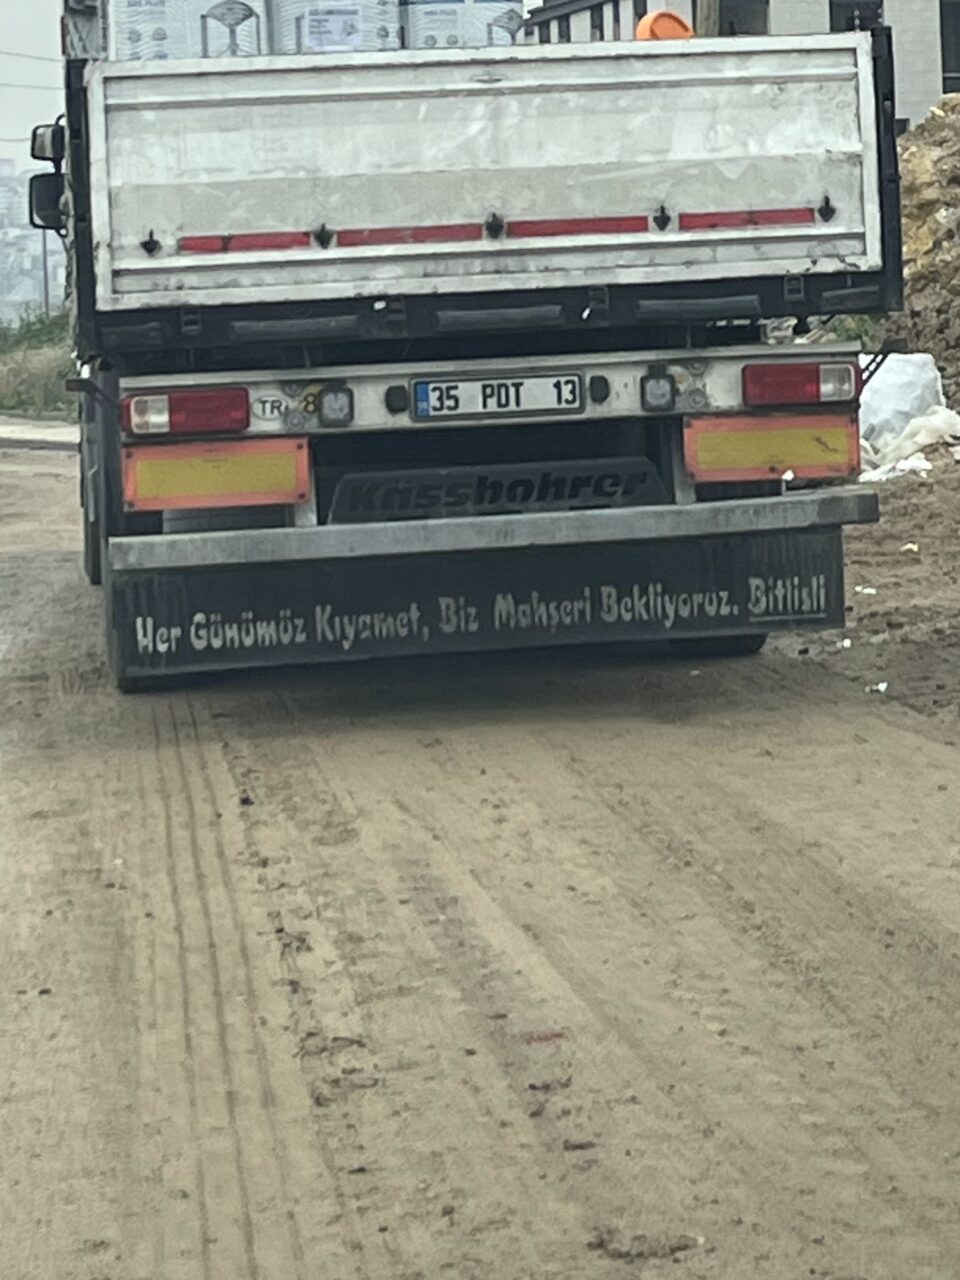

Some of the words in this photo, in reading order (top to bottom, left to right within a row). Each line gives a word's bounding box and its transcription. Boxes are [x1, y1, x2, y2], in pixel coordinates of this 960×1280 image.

[258, 399, 283, 417] TR
[431, 384, 460, 412] 35
[481, 381, 524, 410] PDT
[552, 378, 577, 406] 13
[135, 616, 182, 655] Her
[189, 608, 307, 651] Günümüz
[438, 595, 480, 634] Biz
[493, 586, 592, 634] Mahşeri
[600, 581, 740, 629] Bekliyoruz.
[748, 574, 826, 615] Bitlisli
